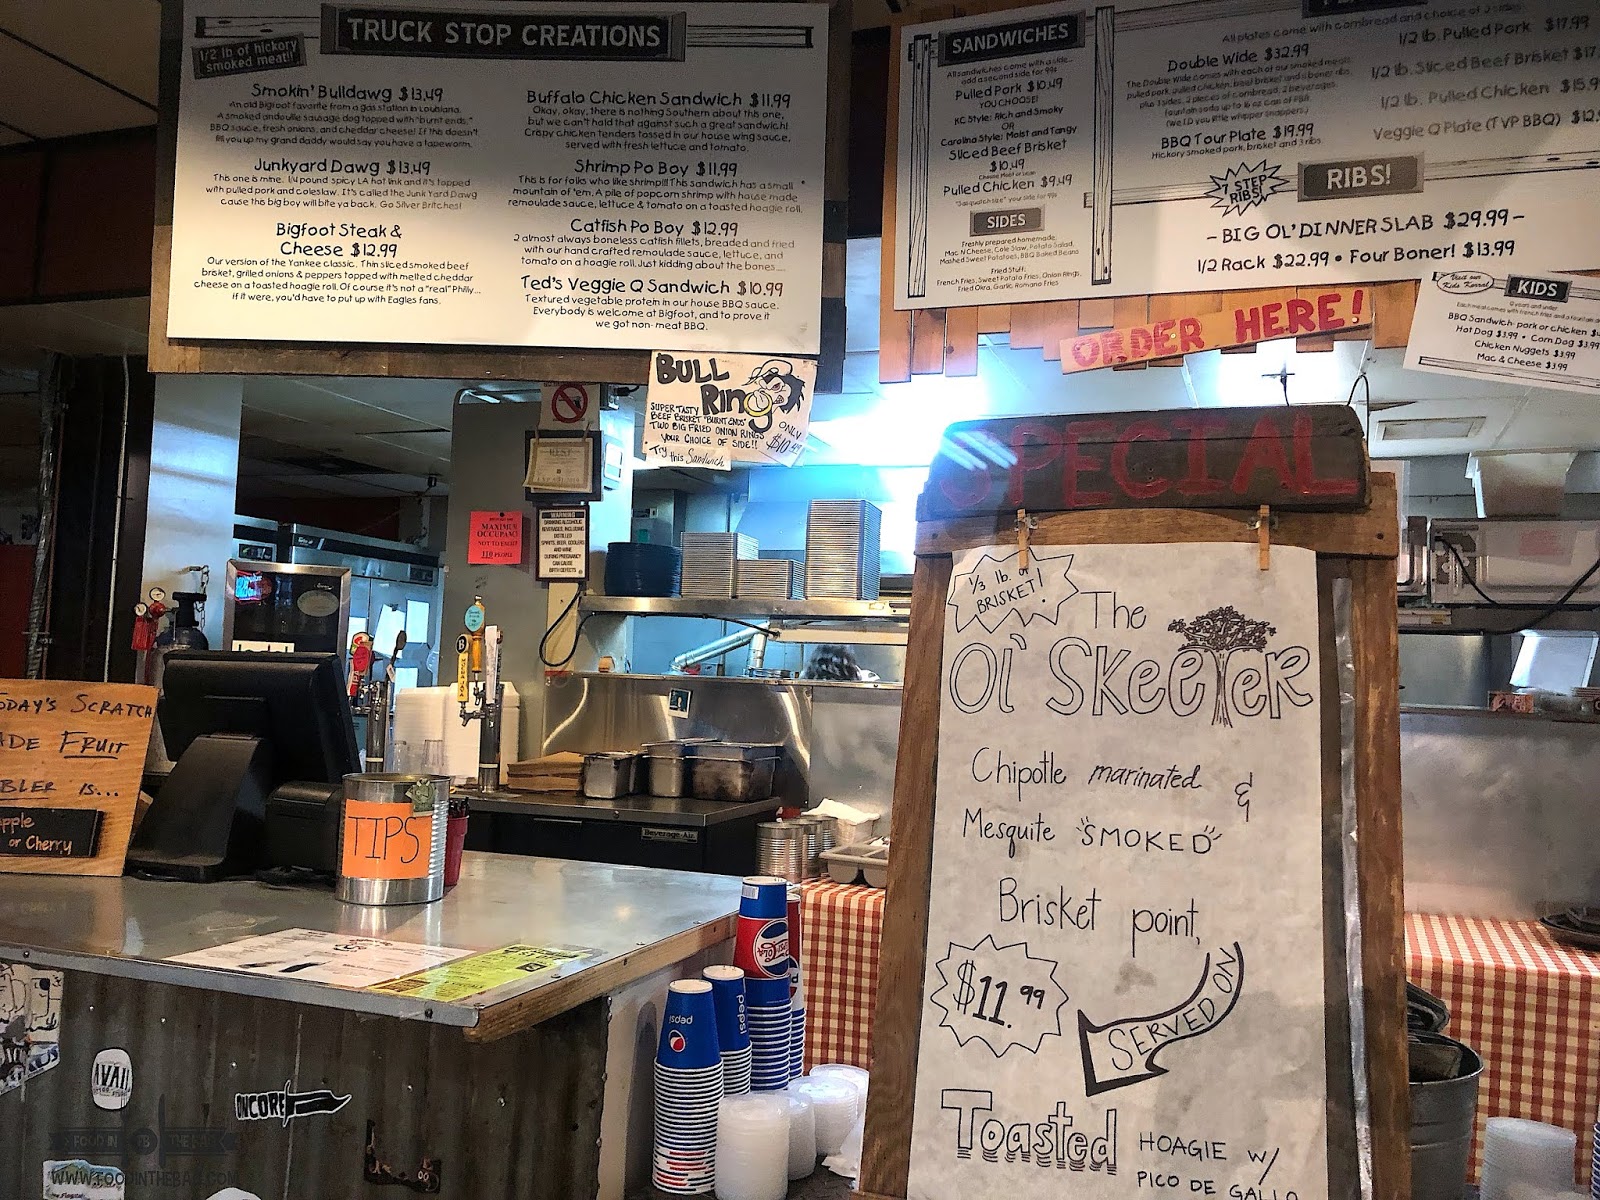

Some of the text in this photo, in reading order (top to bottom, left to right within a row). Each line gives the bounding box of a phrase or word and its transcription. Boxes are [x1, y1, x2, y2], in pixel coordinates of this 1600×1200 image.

[347, 17, 660, 47] TRUCK STOP CREATIONS
[952, 23, 1069, 54] SANDWICHES
[200, 39, 298, 62] 1/2 lb of hickory
[206, 51, 293, 73] smoked meat!!
[1167, 43, 1309, 73] Double Wide $32.99
[251, 83, 443, 103] Smokin' Bulldawg $13.49
[527, 90, 791, 109] Buffalo Chicken Sandwich $11.99
[955, 77, 1063, 101] Pulled Pork $10.49
[1161, 123, 1314, 150] BBQ Tour Plate $19.99
[949, 138, 1067, 161] Sliced Beef Brisket
[254, 158, 431, 177] Junkyard Dawg $13.49
[574, 159, 737, 178] Shrimp Po Boy $11.99
[989, 158, 1025, 173] $10.49
[1327, 164, 1391, 190] RIBS!
[943, 174, 1072, 197] Pulled Chicken $9.49
[1222, 175, 1267, 195] 7 STEP
[1229, 187, 1264, 204] RIBS!
[276, 222, 402, 239] Bigfoot Steak &
[570, 218, 738, 237] Catfish Po Boy $12.99
[987, 214, 1025, 228] SIDES
[1222, 209, 1509, 244] BIG OL' DINNER SLAB $29.99
[280, 241, 397, 258] Cheese $12.99
[1198, 240, 1515, 274] 1/2 Rack $22.99 Four Boner! $13.99
[521, 275, 783, 297] Ted's Veggie Q Sandwich $10.99
[1517, 280, 1557, 297] KIDS
[525, 293, 570, 304] Textured
[571, 295, 623, 306] vegetable
[625, 297, 660, 307] protein
[662, 298, 670, 306] in
[690, 298, 720, 308] house
[722, 299, 743, 309] BBQ
[745, 301, 779, 310] sauce.
[1070, 288, 1366, 368] ORDER HERE!
[1456, 325, 1600, 350] Hot Dog $3.99 Corn Dog $3.99
[1474, 340, 1576, 360] Chicken Nuggets $3.99
[656, 353, 730, 385] BULL
[1477, 353, 1568, 371] Mac & Cheese $3.99
[650, 402, 699, 416] SUPER TASTY
[650, 411, 672, 421] BEEF
[673, 412, 702, 423] BRISKET
[649, 420, 767, 440] TWO BIG FRIED ONION RINGS
[660, 433, 758, 450] YOUR CHOICE OF SIDE!!
[778, 421, 802, 440] ONLY
[649, 444, 725, 467] Try this Sandwich
[940, 413, 1360, 509] SPECIAL
[994, 569, 1011, 584] lb.
[976, 568, 1046, 614] BRISKET!
[1080, 591, 1147, 629] The
[70, 694, 152, 718] SCRATCH
[59, 730, 130, 753] FRUIT
[972, 747, 1067, 802] Chipotle
[1088, 764, 1202, 790] marinated
[348, 816, 420, 864] TIPS
[963, 807, 1056, 859] Mesquite
[8, 835, 72, 855] or Cherry
[999, 877, 1200, 958] Brisket point,
[668, 1014, 693, 1025] pepsi
[736, 994, 747, 1035] pepsi
[1107, 946, 1238, 1072] SERVED ON
[941, 1088, 1118, 1176] Toasted
[1139, 1131, 1227, 1162] HOAGIE
[1137, 1171, 1179, 1188] PICO
[1190, 1180, 1216, 1195] DE
